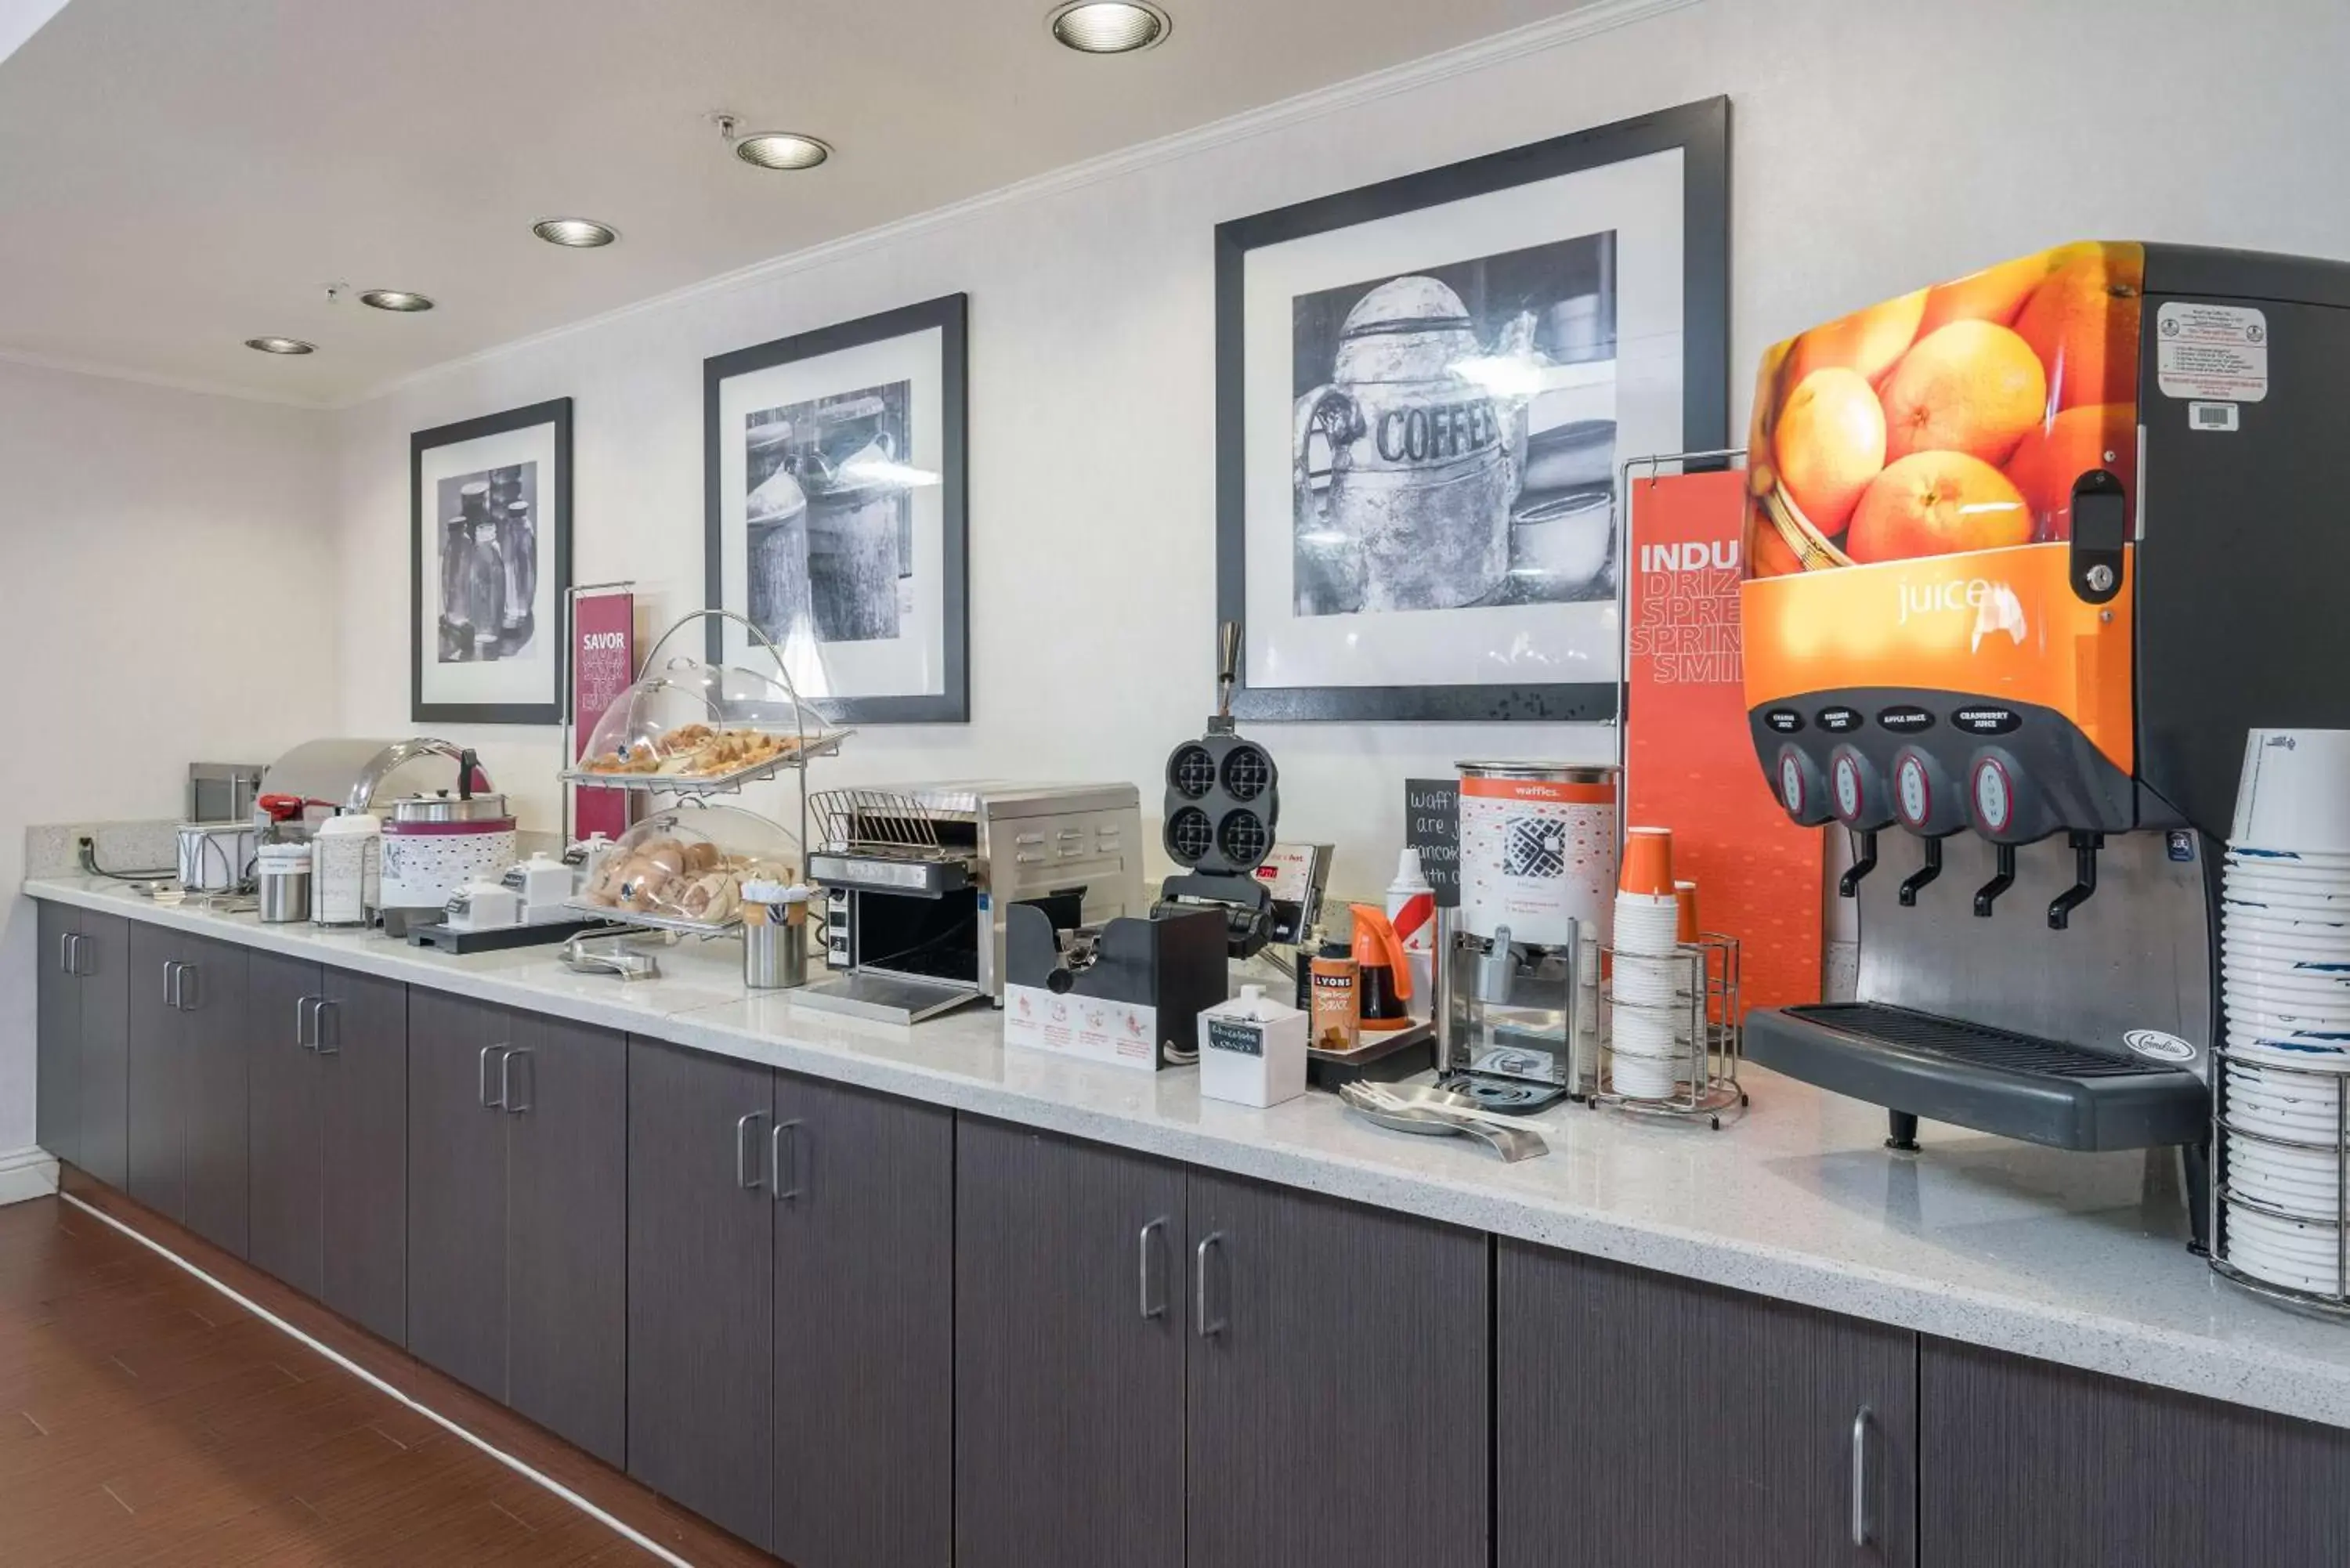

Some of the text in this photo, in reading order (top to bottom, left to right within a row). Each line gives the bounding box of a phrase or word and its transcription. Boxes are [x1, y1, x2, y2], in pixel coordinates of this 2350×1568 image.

[1897, 572, 1991, 626] juice
[583, 632, 625, 650] SAVOR
[1960, 712, 2009, 721] CRANBERRY
[1416, 817, 1444, 834] are
[1317, 977, 1351, 986] LYONS
